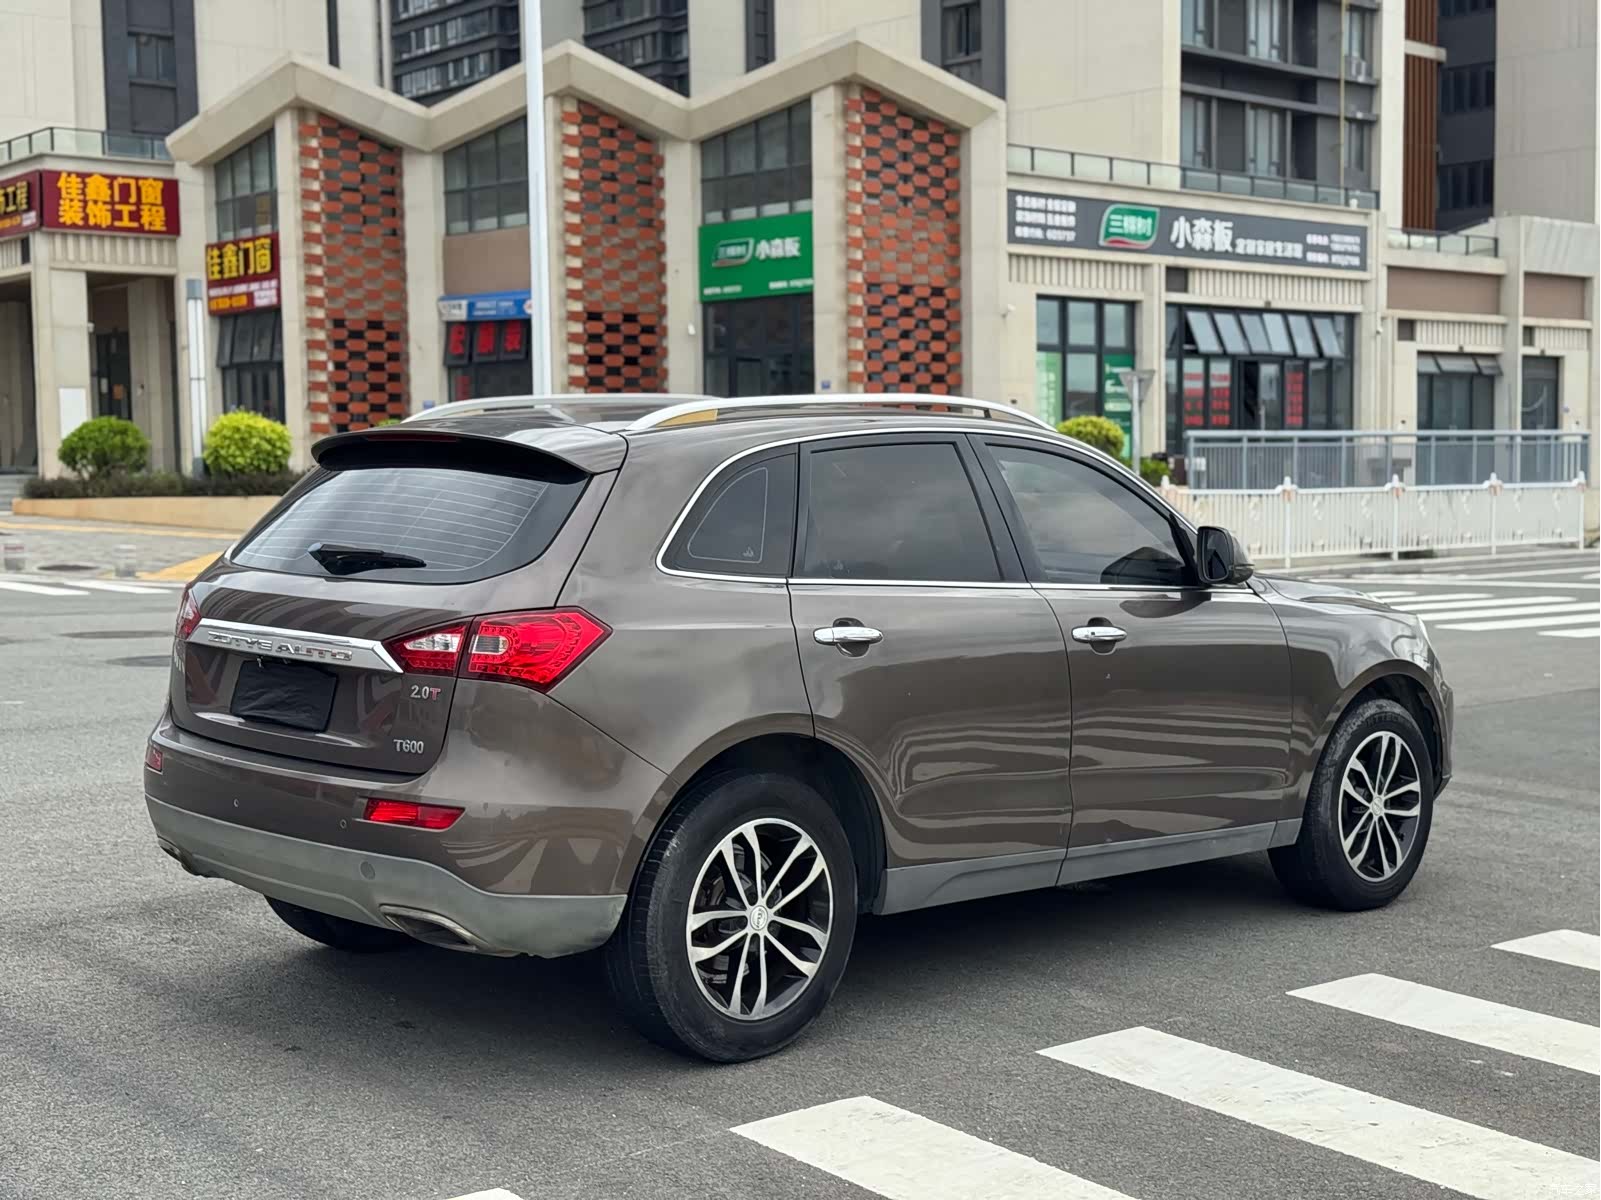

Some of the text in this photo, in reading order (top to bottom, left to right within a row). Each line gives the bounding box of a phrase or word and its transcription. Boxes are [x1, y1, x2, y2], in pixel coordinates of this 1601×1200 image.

[57, 171, 164, 205] 佳鑫门窗
[58, 198, 167, 231] 装饰工程
[1169, 215, 1234, 253] 小森板
[207, 236, 272, 280] 佳鑫门窗
[410, 684, 442, 701] 2.0T
[393, 738, 425, 754] T600
